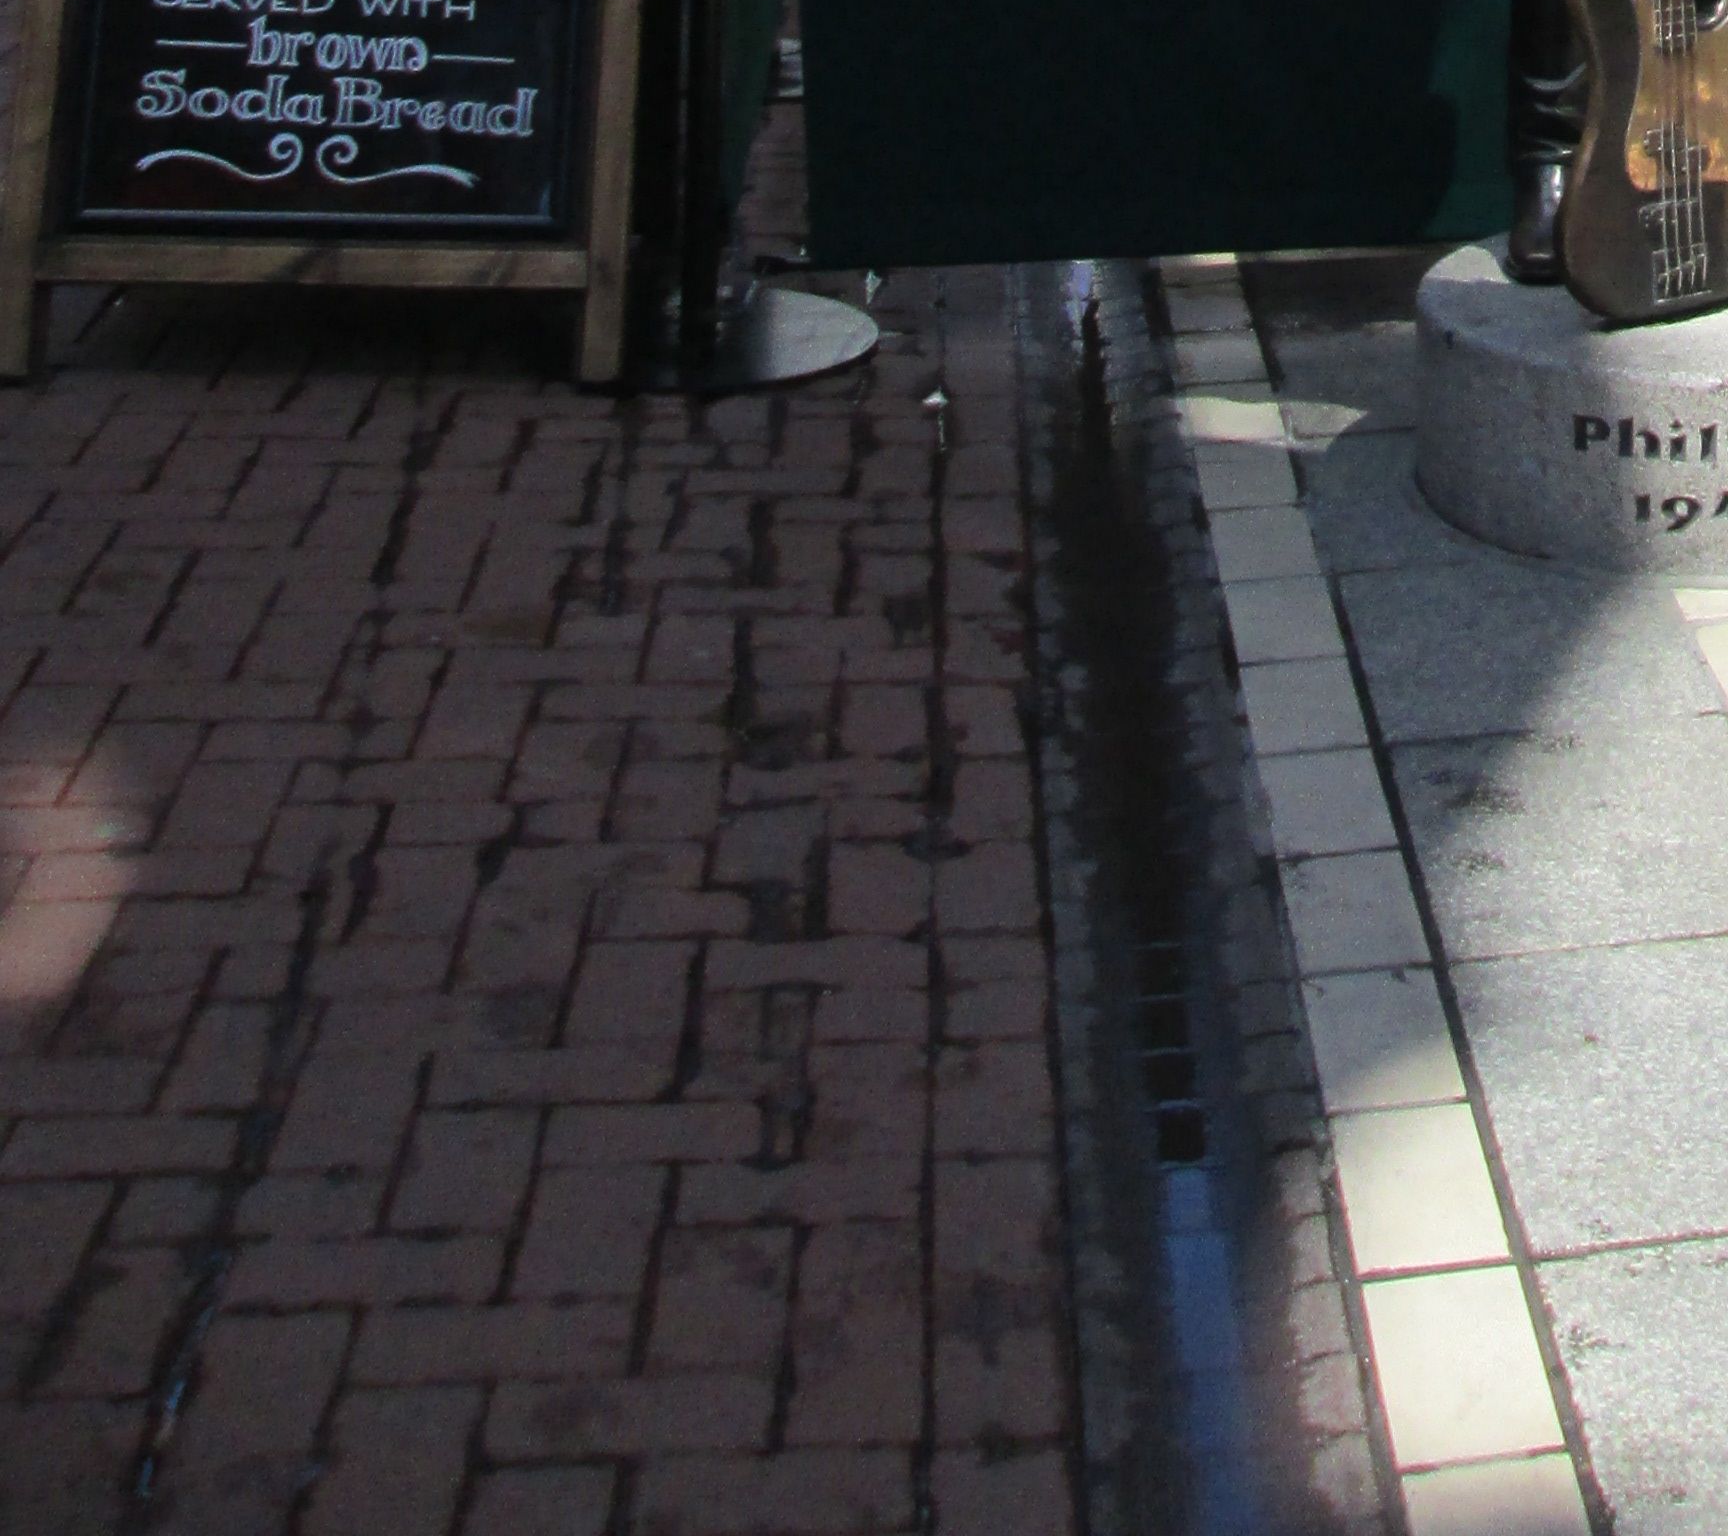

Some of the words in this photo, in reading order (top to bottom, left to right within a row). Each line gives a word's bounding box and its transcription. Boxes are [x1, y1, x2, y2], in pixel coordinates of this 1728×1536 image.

[246, 15, 429, 73] brown
[136, 68, 327, 124] Soda
[332, 75, 539, 137] Bread
